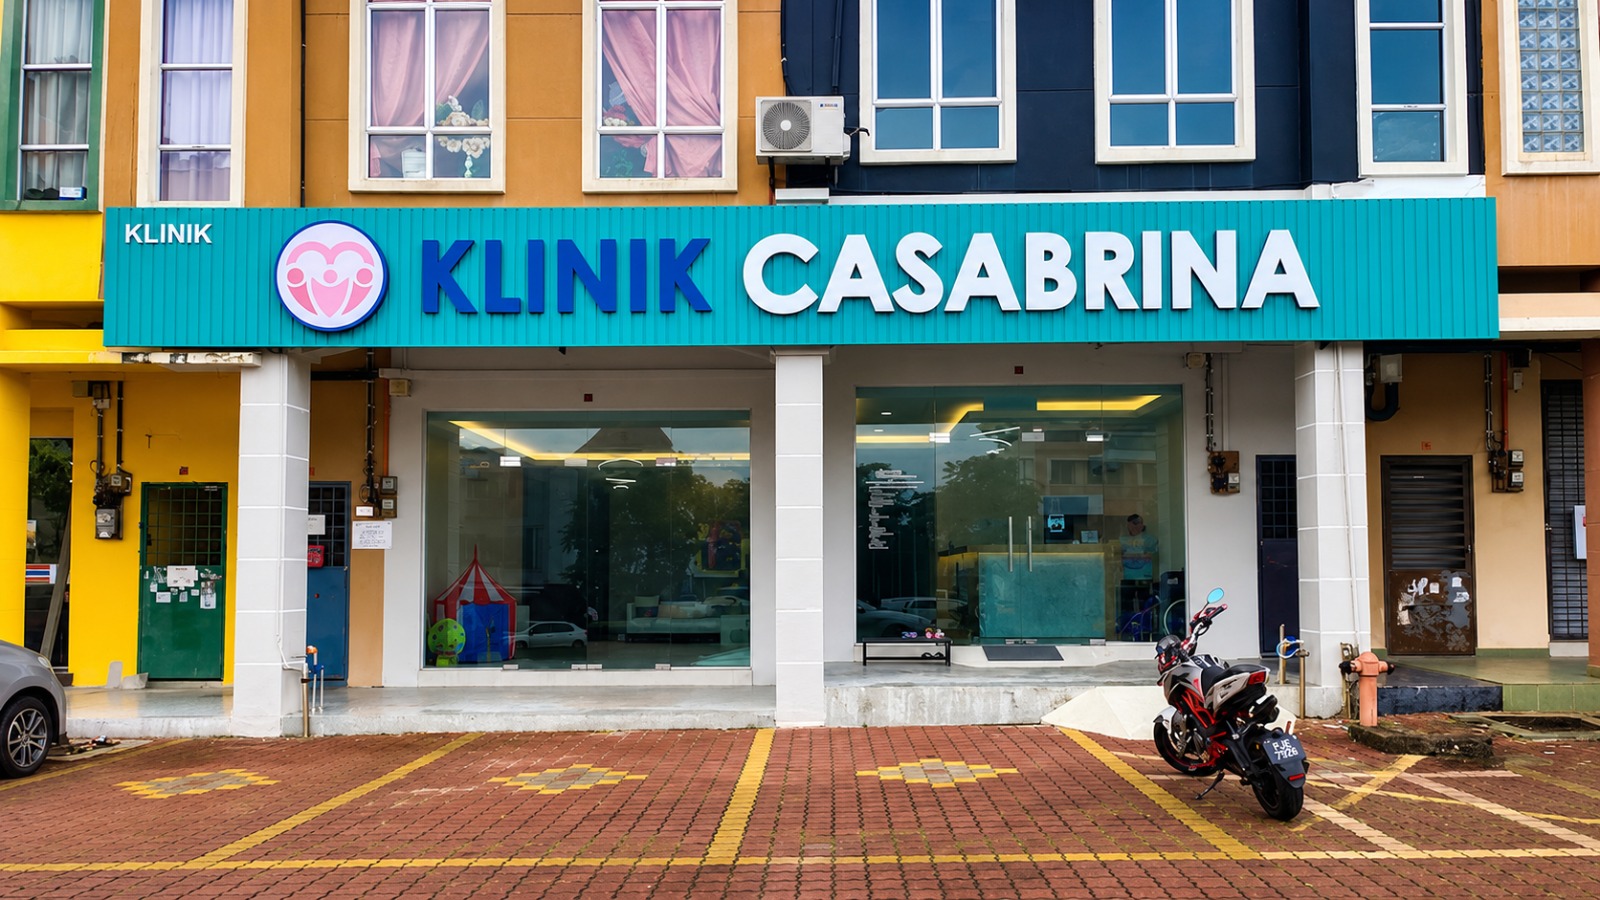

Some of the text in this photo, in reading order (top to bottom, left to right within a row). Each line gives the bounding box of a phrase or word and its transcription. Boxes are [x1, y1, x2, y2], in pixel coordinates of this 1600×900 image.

[124, 222, 213, 245] KLINIK
[421, 229, 1321, 315] KLINIK CASABRINA
